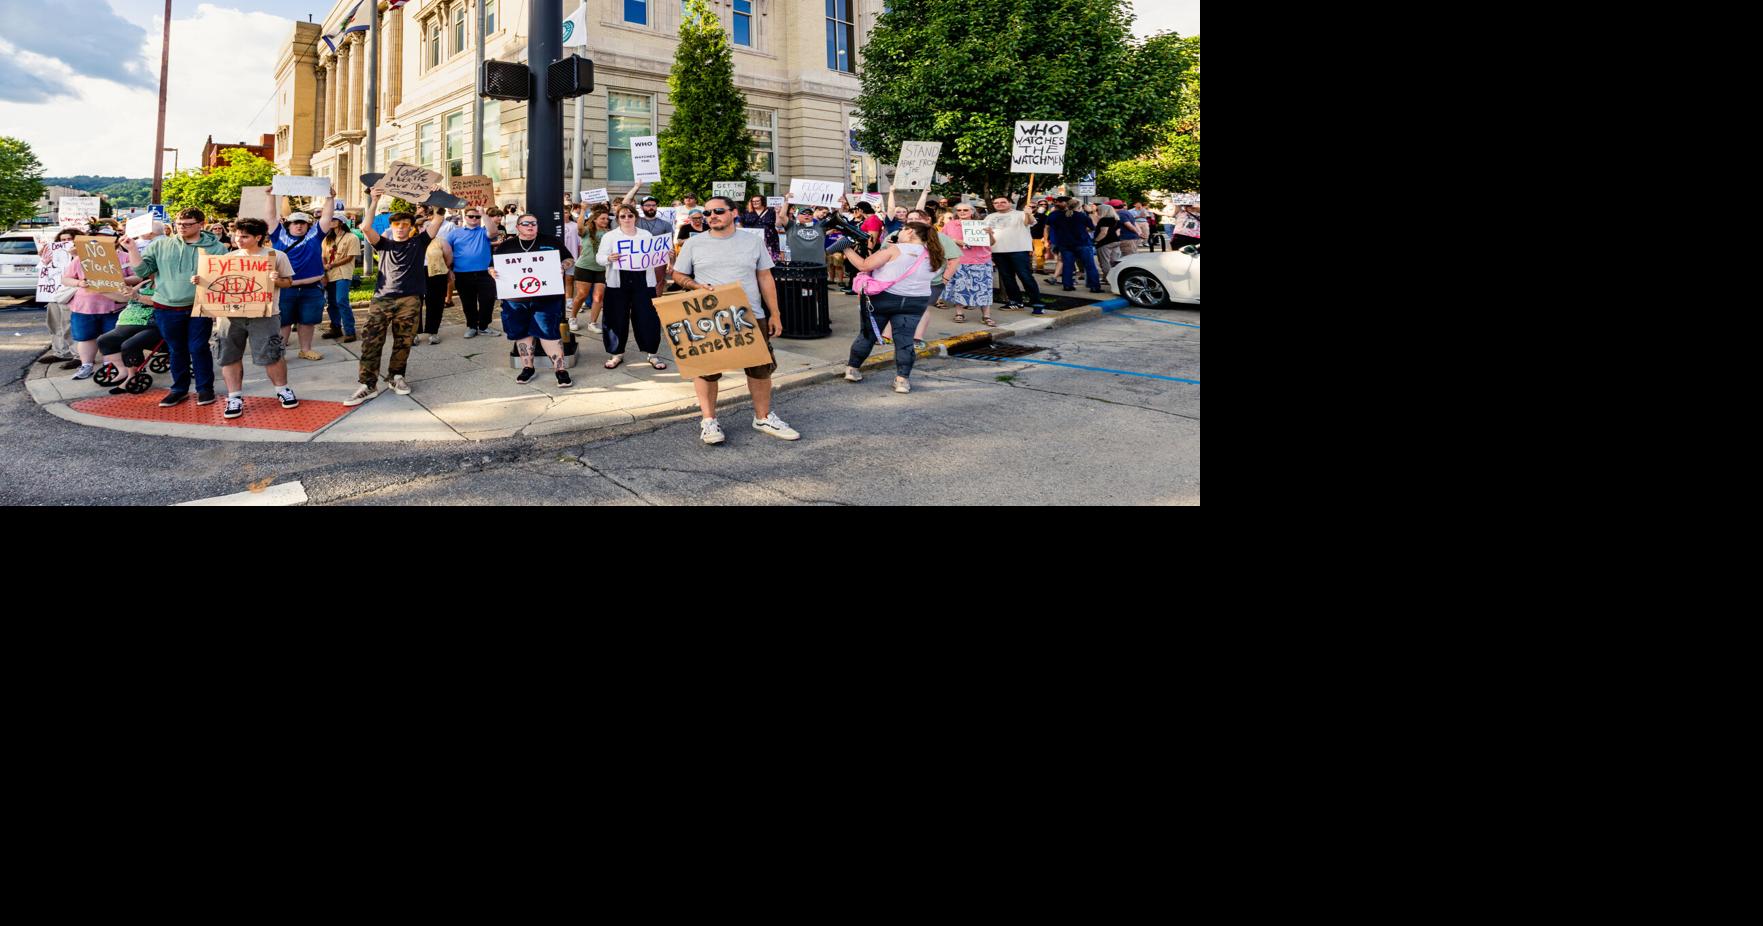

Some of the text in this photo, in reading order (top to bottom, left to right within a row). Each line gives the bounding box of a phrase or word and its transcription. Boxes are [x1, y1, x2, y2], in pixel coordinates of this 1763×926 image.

[1020, 123, 1062, 136] WHO
[1014, 136, 1064, 145] WATCHES
[905, 144, 939, 158] STAND
[1018, 145, 1059, 155] THE
[1012, 155, 1064, 166] WATCHMEN
[802, 183, 830, 192] FLOCK
[802, 193, 833, 203] NO!!!
[964, 228, 988, 236] FLOC
[85, 243, 106, 258] NO
[617, 236, 671, 255] FLUCK
[208, 257, 273, 275] EYE HAVE
[505, 257, 522, 265] SAY
[617, 251, 669, 270] FLOCK
[513, 280, 547, 290] FLOCK
[682, 294, 719, 316] NO
[666, 305, 755, 346] FLOCK
[675, 331, 756, 360] cameras
